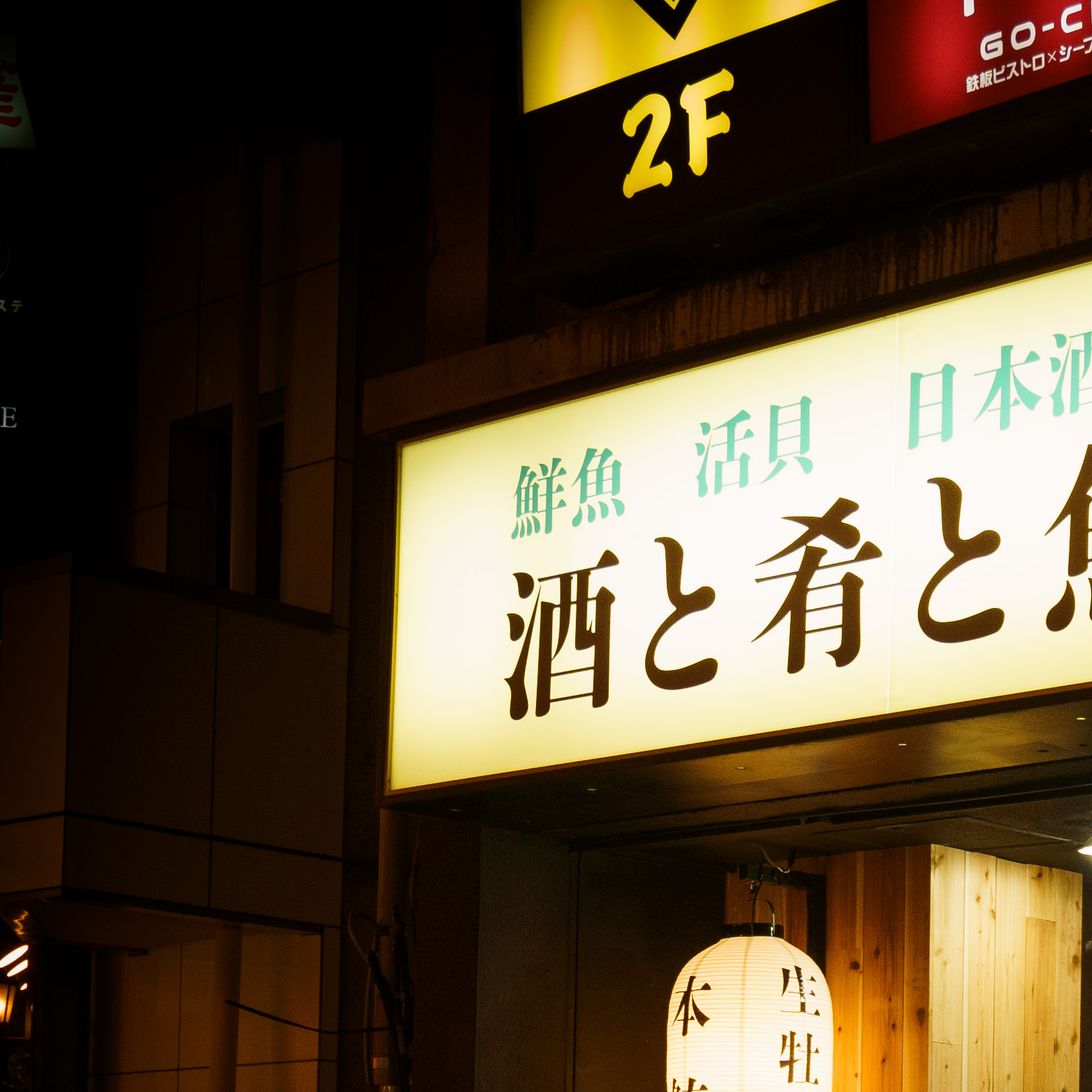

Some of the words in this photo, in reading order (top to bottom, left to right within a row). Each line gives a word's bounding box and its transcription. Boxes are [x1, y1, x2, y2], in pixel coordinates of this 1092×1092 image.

[622, 68, 735, 199] 2F
[510, 446, 626, 541] 鮮魚
[694, 395, 815, 498] 活貝
